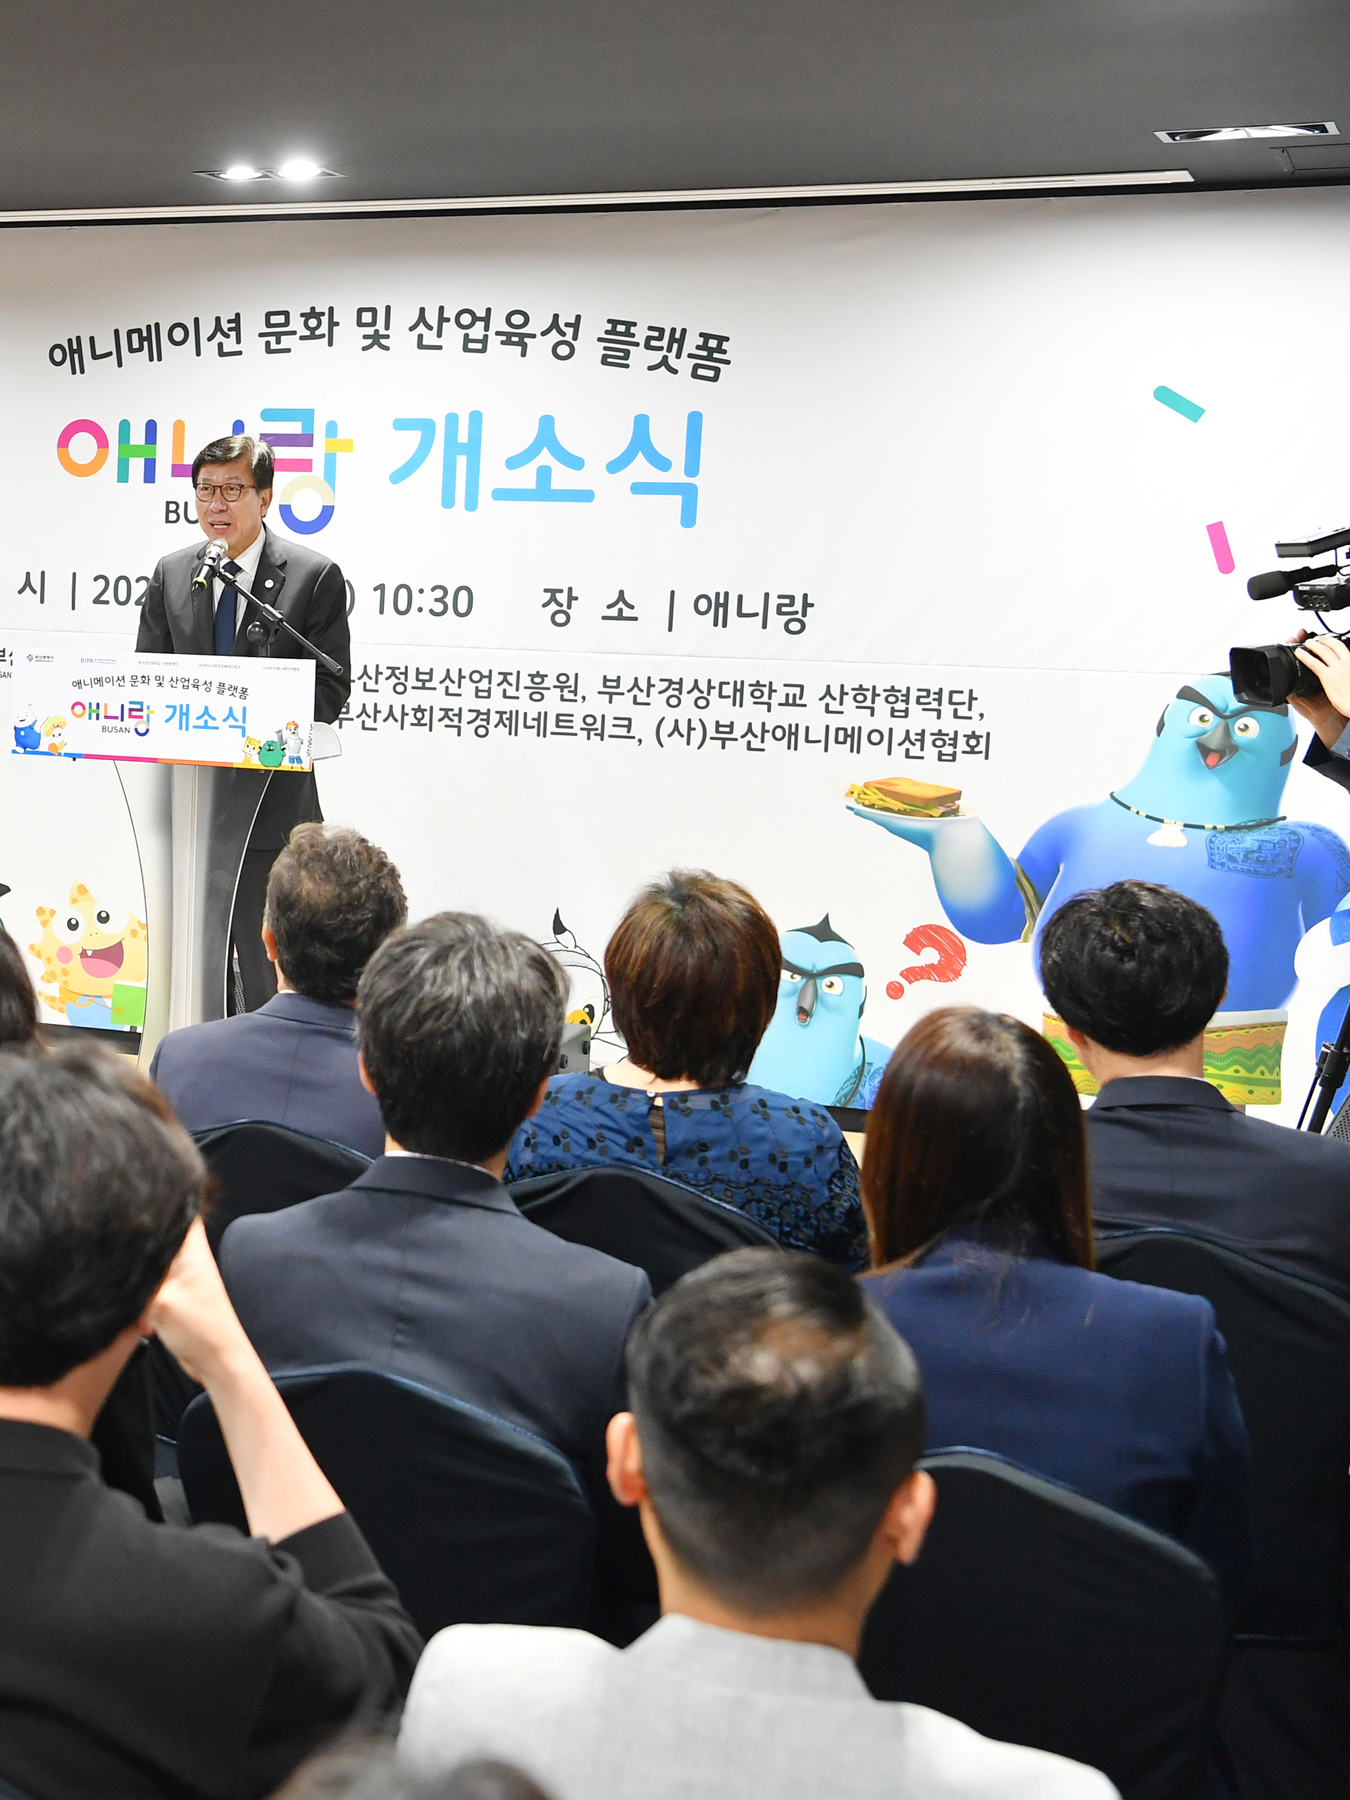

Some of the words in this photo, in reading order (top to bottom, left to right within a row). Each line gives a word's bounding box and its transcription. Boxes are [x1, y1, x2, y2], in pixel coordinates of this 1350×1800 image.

[49, 312, 242, 375] 애니메이션
[258, 305, 340, 354] 문화
[356, 305, 391, 351] 및
[408, 305, 582, 361] 산업육성
[596, 318, 732, 383] 플랫폼
[388, 409, 703, 529] 개소식
[17, 570, 46, 605] 시
[372, 582, 474, 618] 10:30
[542, 586, 579, 628] 장
[600, 589, 639, 622] 소
[693, 590, 814, 636] 애니랑
[72, 674, 126, 690] 애니메이션
[129, 674, 151, 687] 문화
[155, 675, 165, 688] 및
[168, 676, 213, 693] 산업육성
[216, 682, 249, 700] 플랫폼
[350, 663, 587, 704] 산정보산업진흥원,
[597, 674, 807, 712] 부산경상대학교
[818, 683, 985, 722] 산학협력단,
[70, 700, 155, 737] 애니랑
[164, 702, 248, 738] 개소식
[101, 725, 131, 735] BUSAN
[655, 717, 991, 763] (사)부산애니메이션협회
